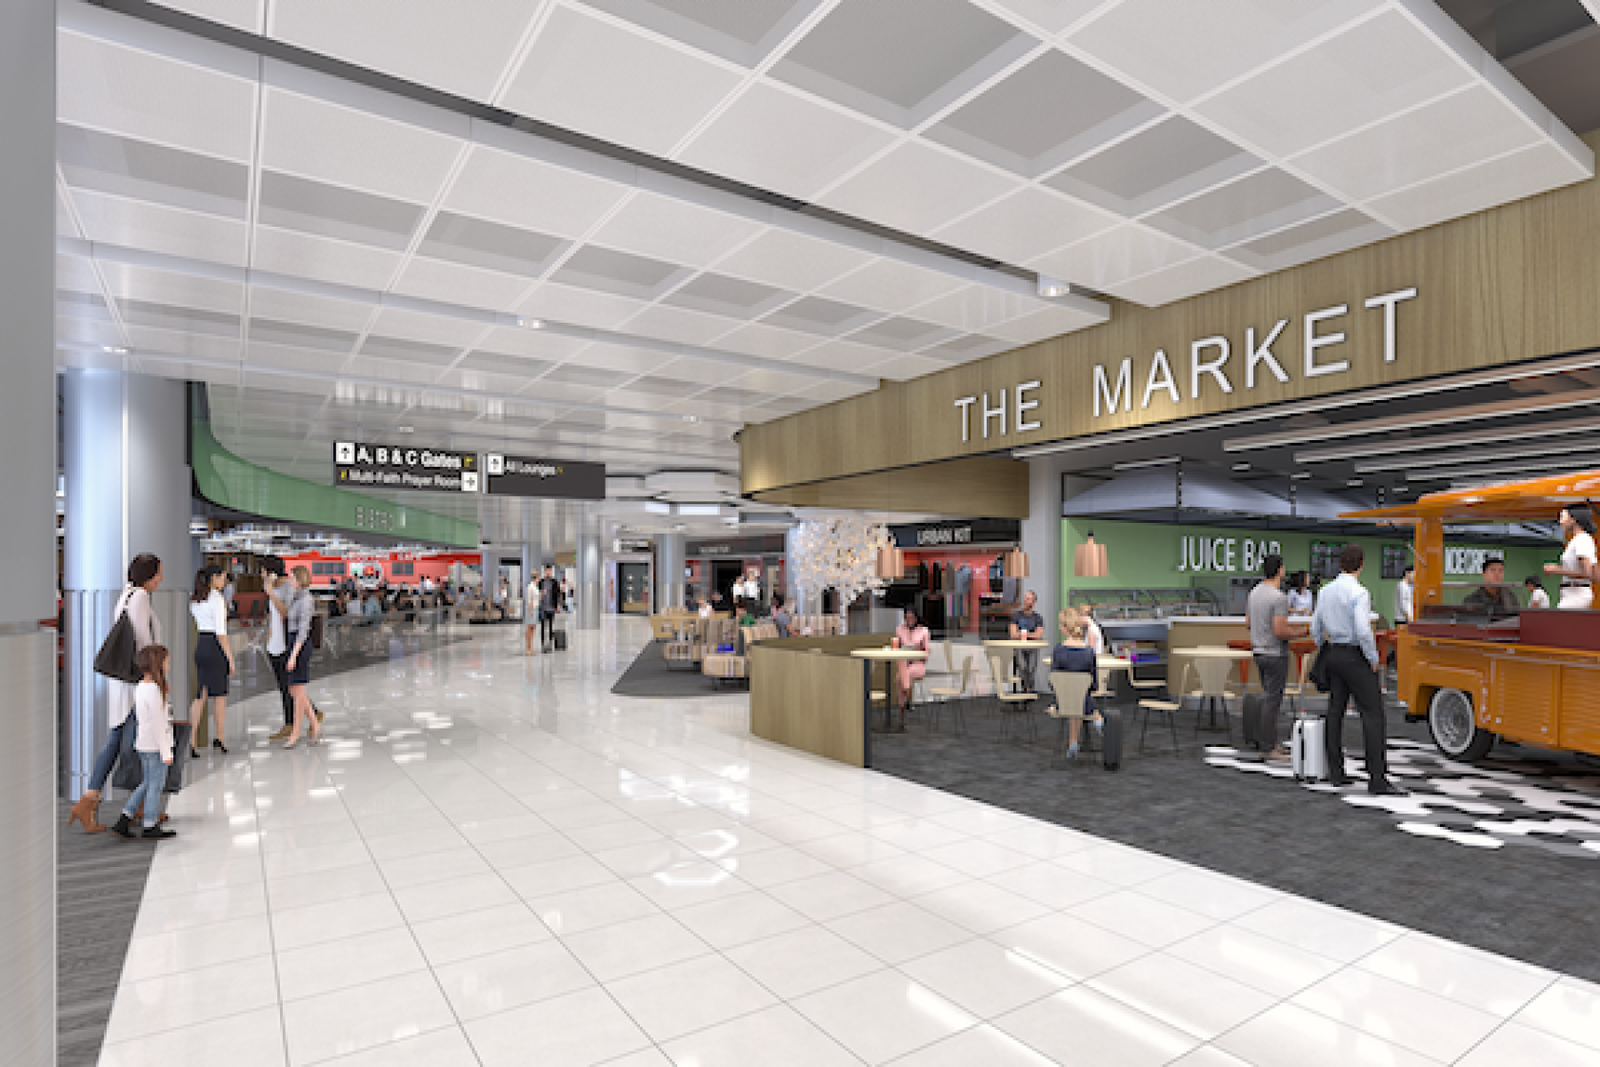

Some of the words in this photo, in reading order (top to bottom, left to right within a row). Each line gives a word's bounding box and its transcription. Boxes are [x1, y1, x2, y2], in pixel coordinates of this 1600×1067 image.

[954, 380, 1041, 442] THE
[1092, 287, 1418, 418] MARKET
[375, 447, 388, 464] B
[391, 448, 402, 465] &
[405, 449, 418, 466] C
[421, 450, 461, 468] Gates
[1177, 536, 1236, 572] JUICE
